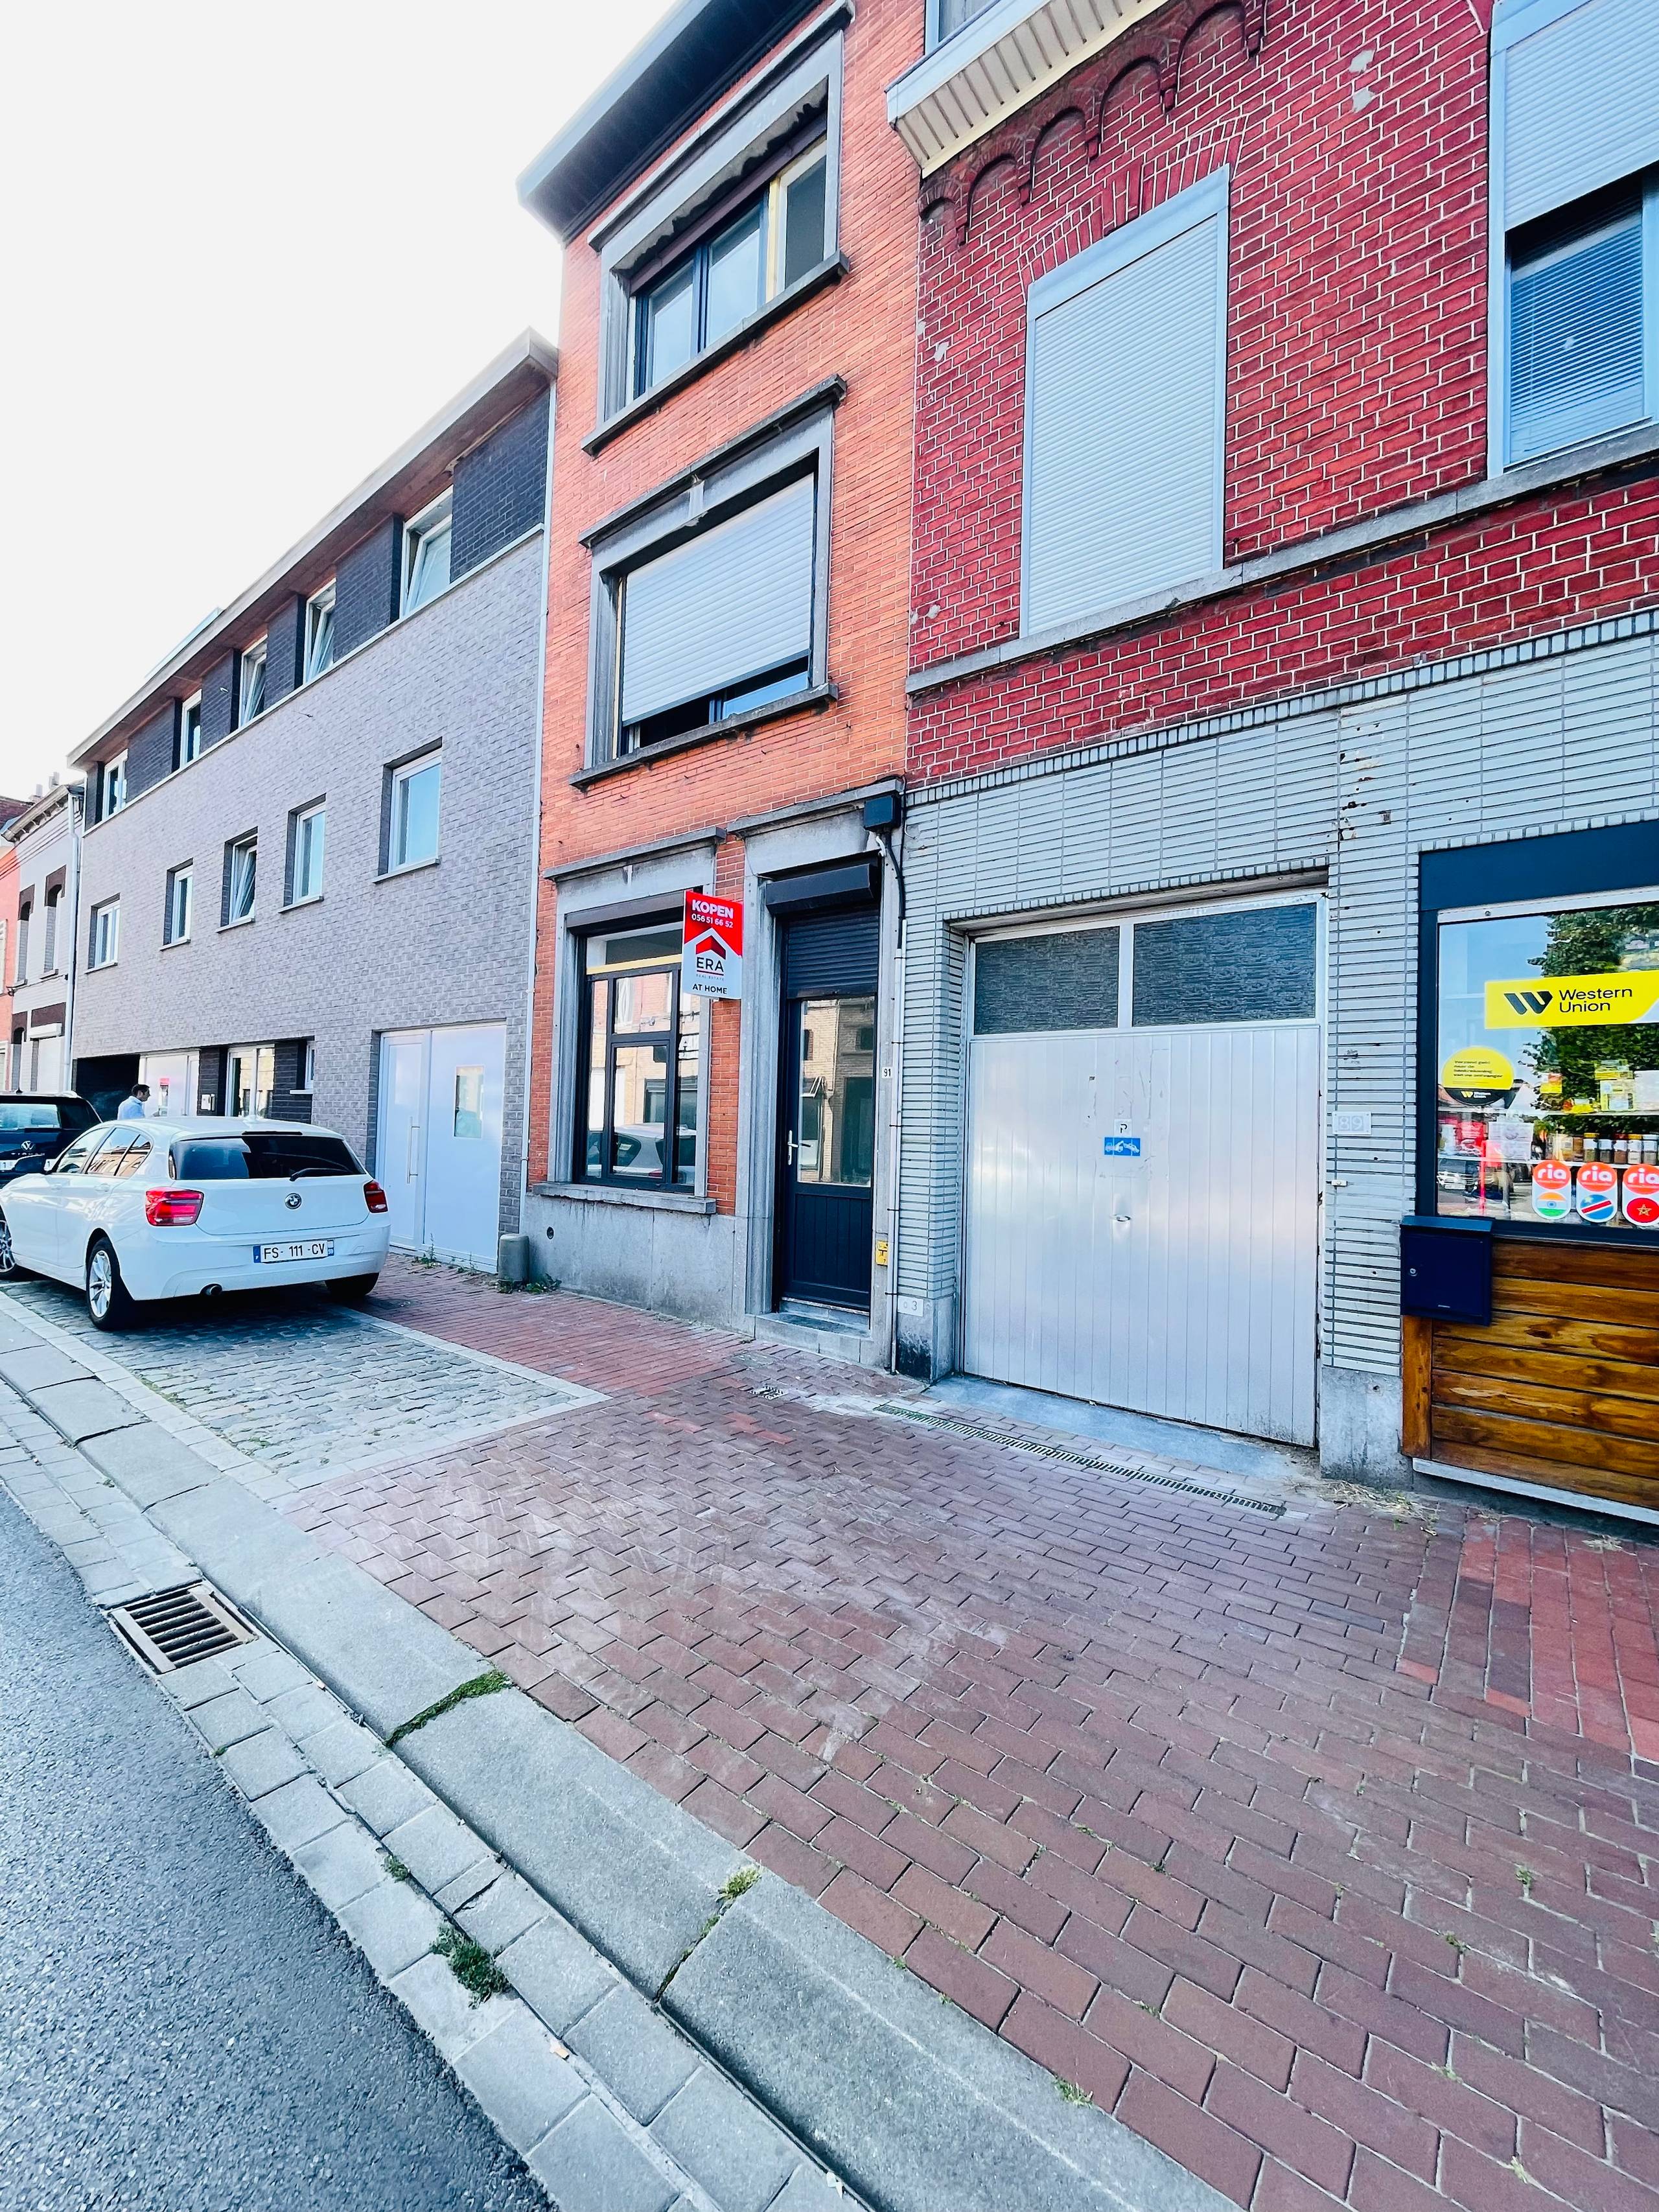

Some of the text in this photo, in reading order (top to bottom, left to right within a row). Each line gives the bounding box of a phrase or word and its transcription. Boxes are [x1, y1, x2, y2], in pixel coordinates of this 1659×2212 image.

[692, 900, 734, 919] KOPEN
[691, 913, 705, 922] 056
[714, 918, 723, 926] 66
[725, 920, 734, 928] 52
[697, 957, 724, 972] ERA
[704, 985, 727, 994] HOME
[1559, 988, 1632, 1001] Western
[1559, 1001, 1610, 1012] Union
[884, 1068, 891, 1077] 91
[1340, 1116, 1363, 1130] 89
[1537, 1163, 1567, 1180] ria
[1582, 1165, 1613, 1182] ria
